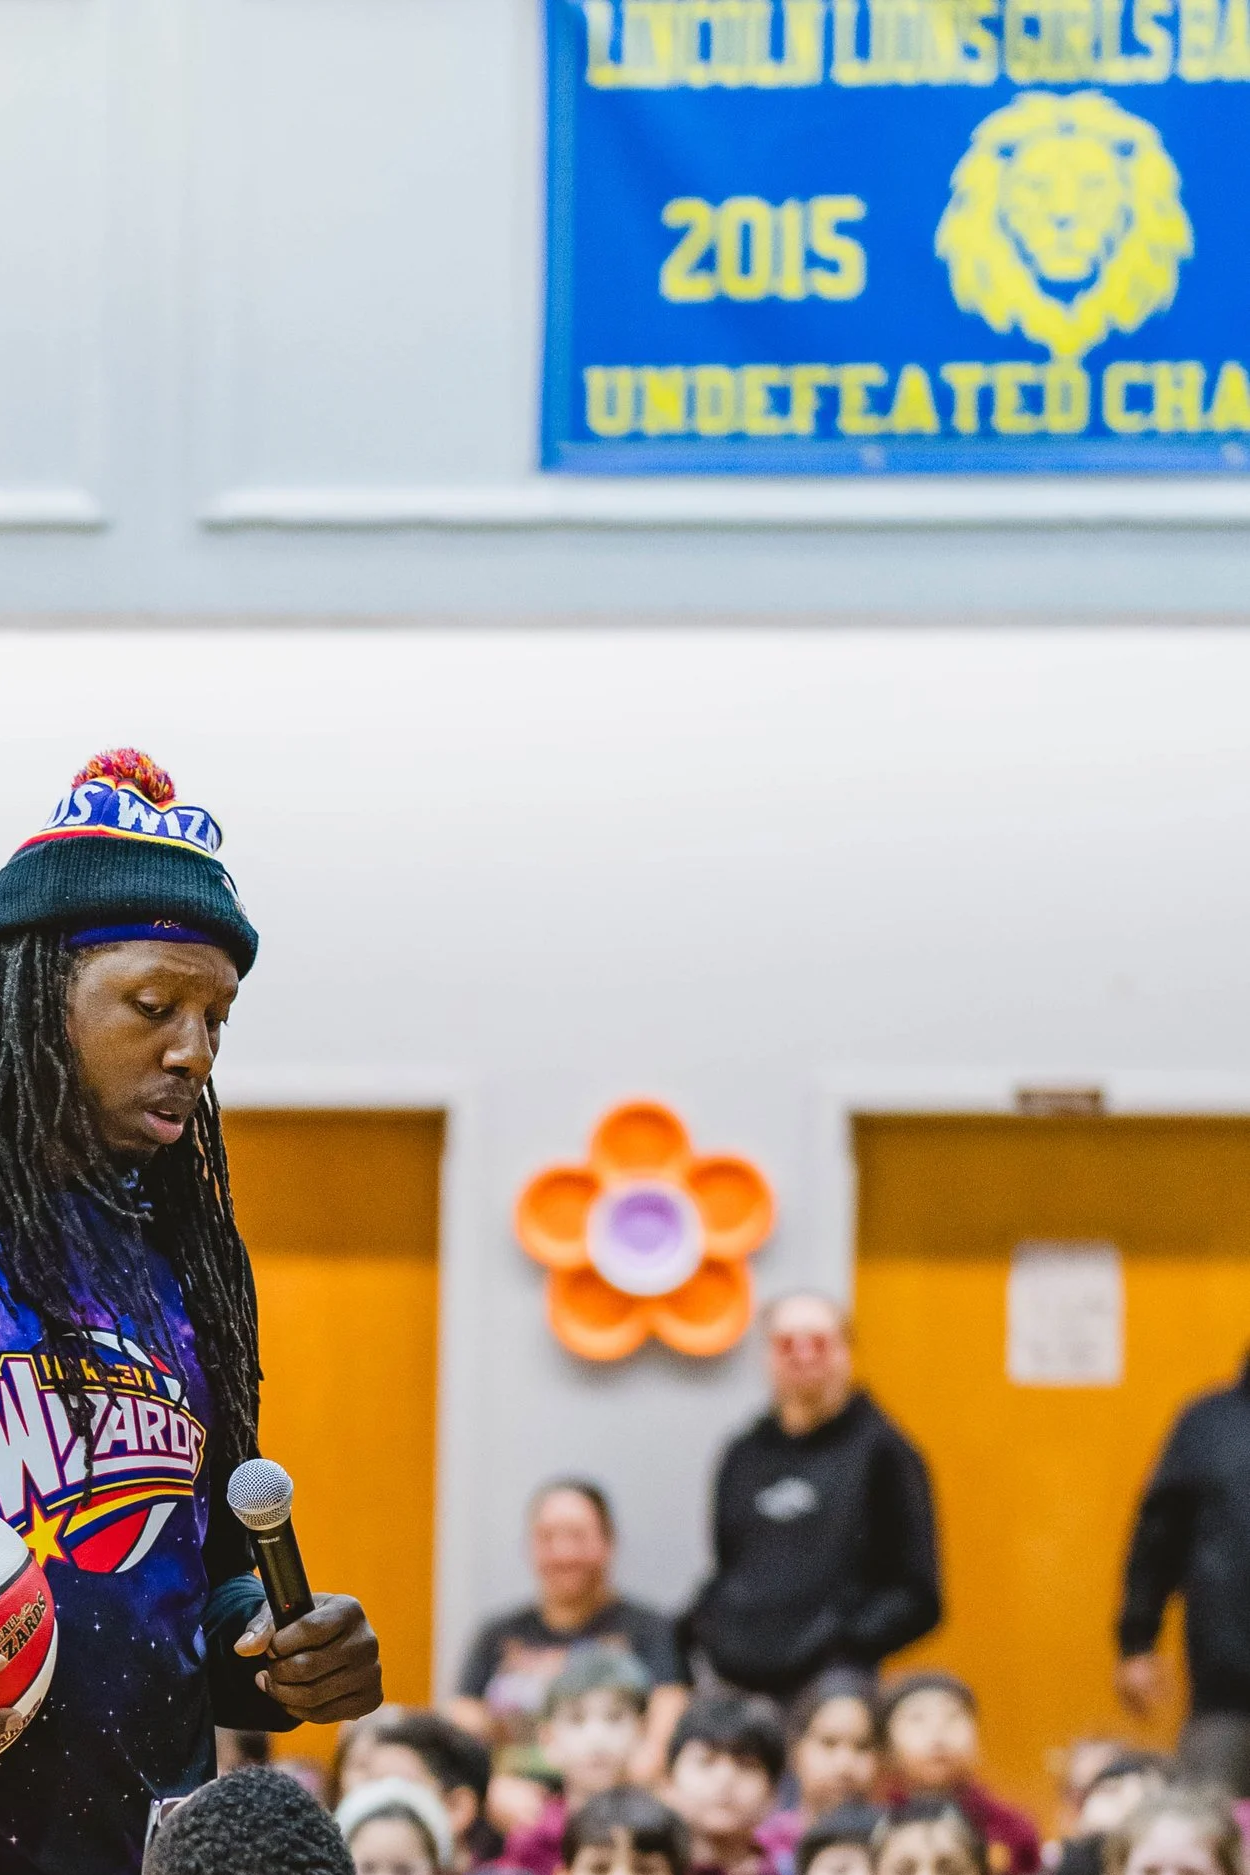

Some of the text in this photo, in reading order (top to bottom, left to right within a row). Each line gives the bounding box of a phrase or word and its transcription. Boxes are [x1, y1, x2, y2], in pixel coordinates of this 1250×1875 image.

[586, 0, 823, 87] LINCOLN
[829, 0, 999, 85] LIONS
[1001, 0, 1175, 83] GIRLS
[660, 195, 867, 301] 2015
[584, 363, 1090, 436] UNDEFEATED
